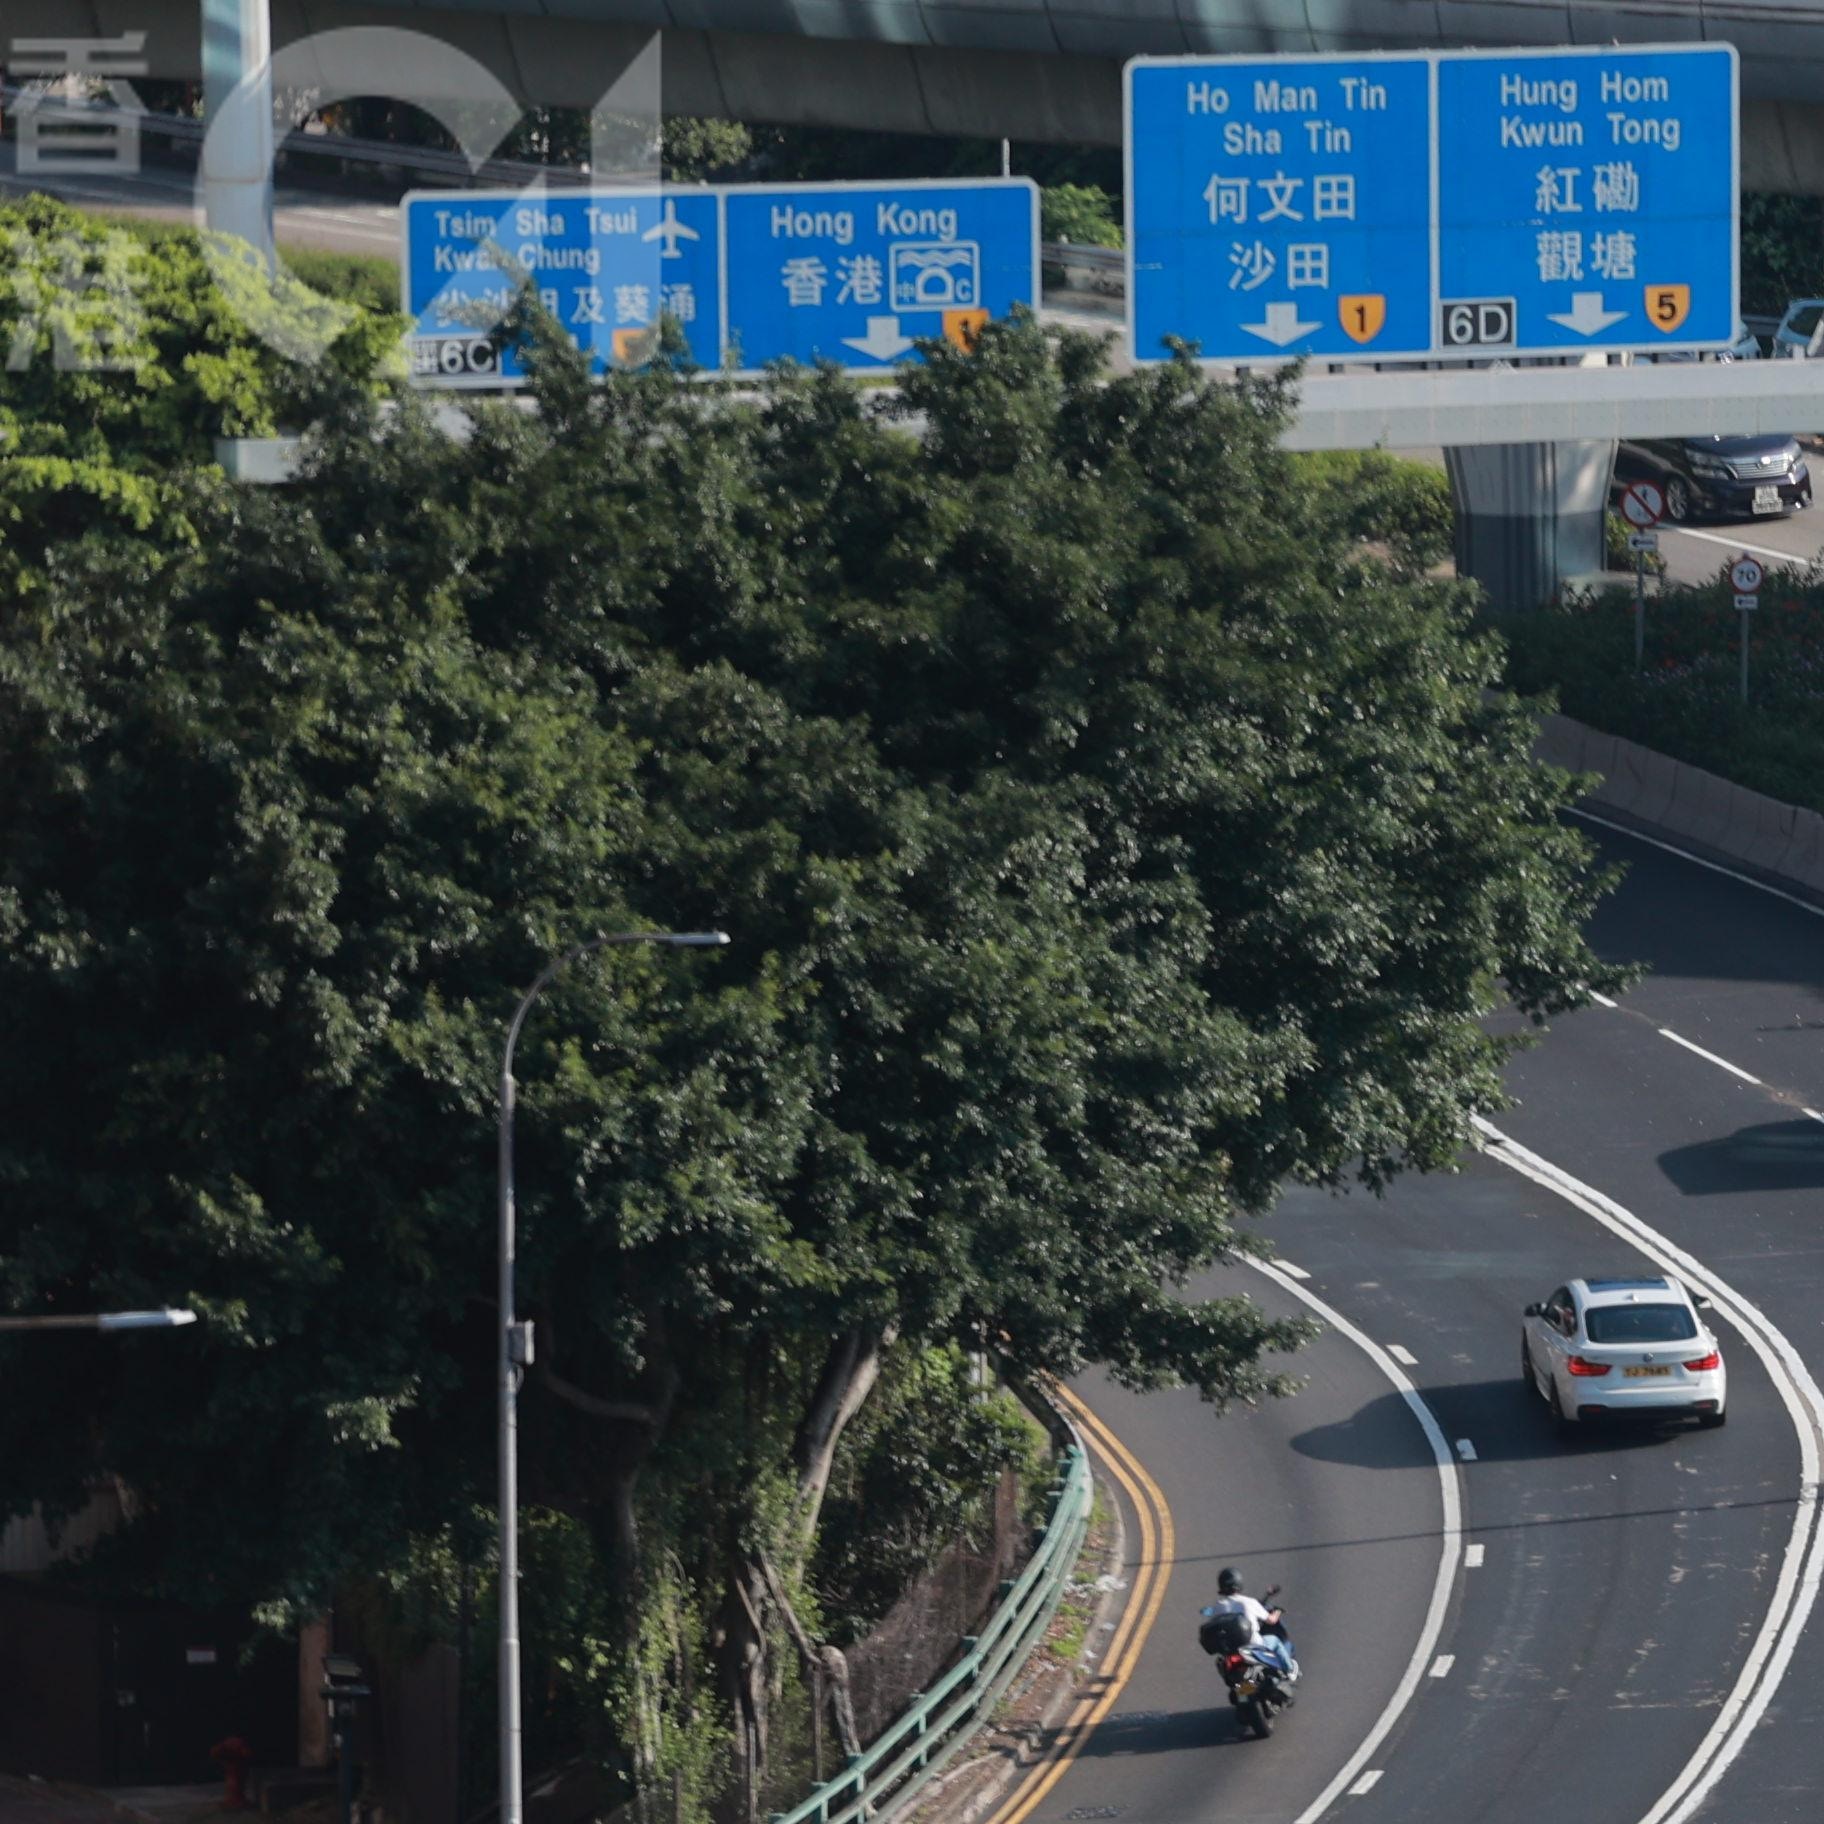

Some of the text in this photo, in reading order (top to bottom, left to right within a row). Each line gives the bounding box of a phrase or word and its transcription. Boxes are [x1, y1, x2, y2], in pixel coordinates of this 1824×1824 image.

[1186, 77, 1388, 115] Ho Man Tin
[1499, 71, 1670, 112] Hung Hom
[1223, 120, 1352, 155] Sha Tin
[1500, 112, 1680, 151] Kwun Tong
[1203, 171, 1358, 225] 何文田
[1535, 162, 1640, 213] 紅磡
[434, 204, 638, 239] Tsim Sha Tsui
[772, 201, 957, 244] Hong Kong
[518, 241, 601, 276] Chung
[1228, 240, 1331, 290] 沙田
[1535, 231, 1638, 282] 觀塘
[780, 254, 883, 307] 香港
[956, 281, 972, 301] C
[1353, 304, 1367, 334] 1
[1447, 302, 1510, 346] 6D
[1655, 292, 1678, 325] 5
[440, 339, 497, 375] 6C
